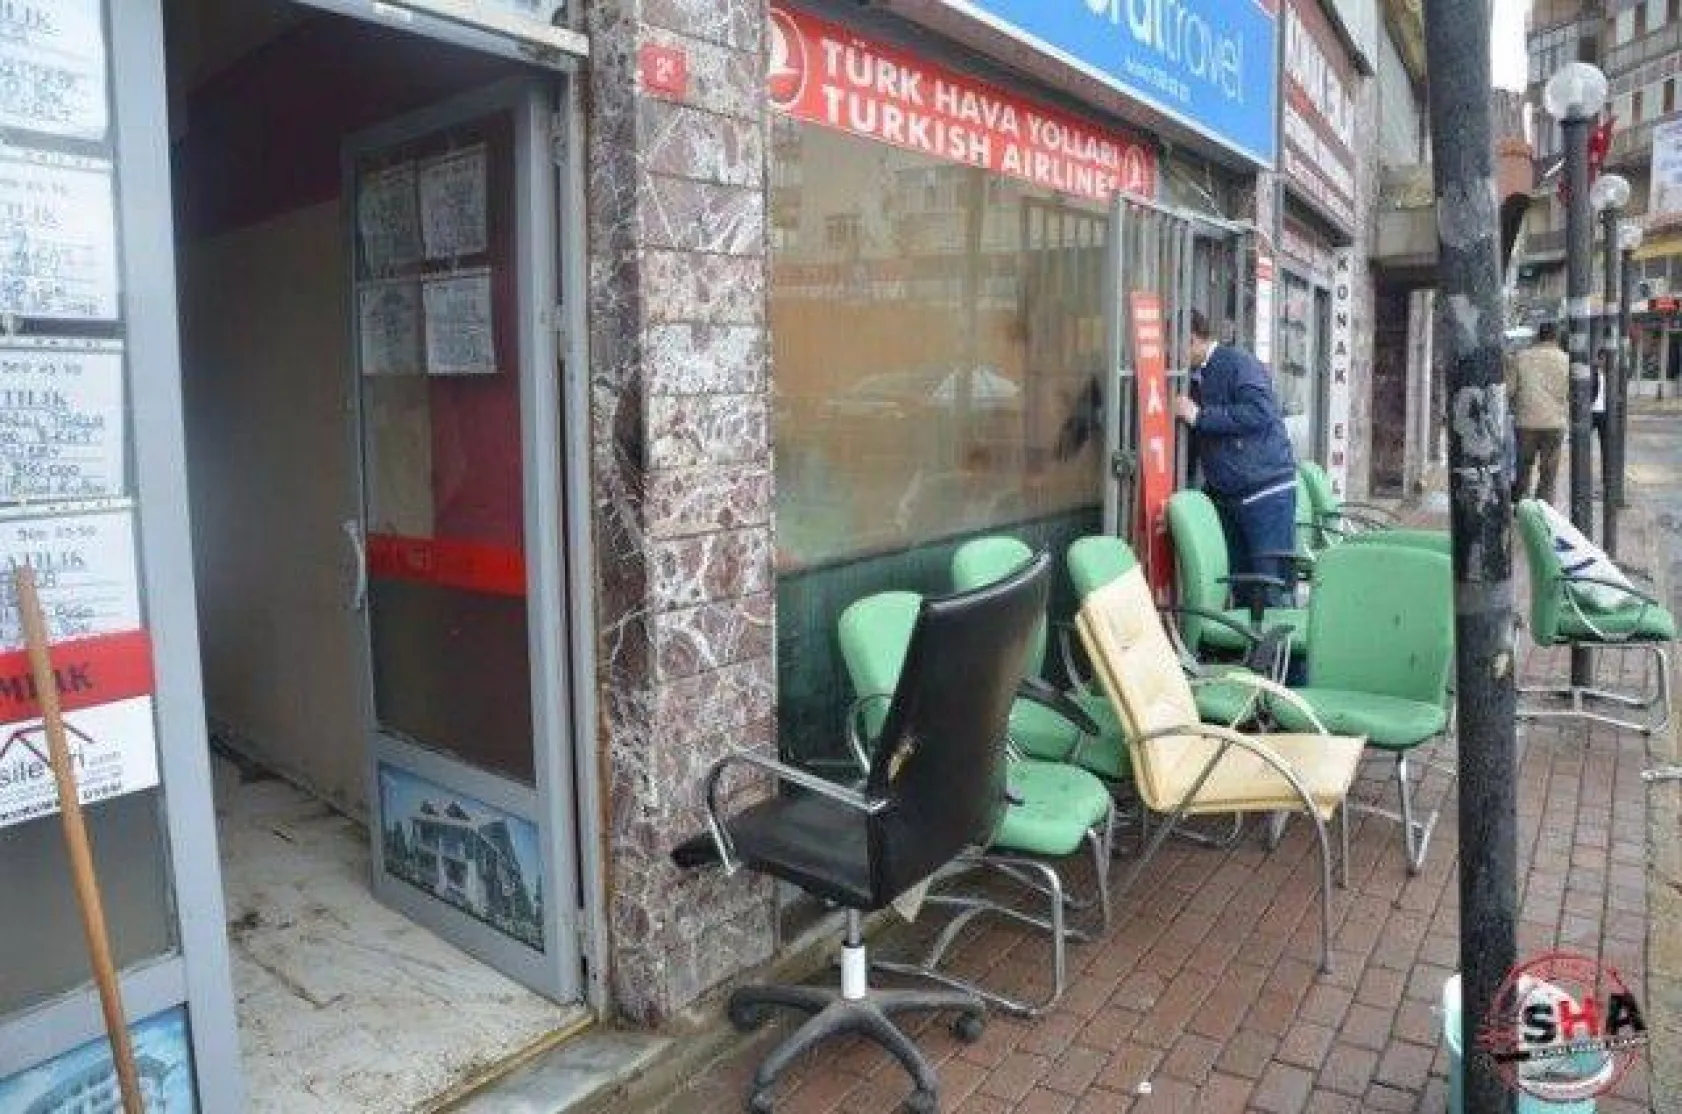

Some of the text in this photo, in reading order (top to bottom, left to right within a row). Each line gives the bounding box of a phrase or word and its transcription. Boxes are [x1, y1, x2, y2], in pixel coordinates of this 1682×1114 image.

[822, 38, 923, 106] TÜRK
[935, 82, 1019, 136] HAVA
[822, 85, 991, 166] TURKISH
[1334, 256, 1349, 385] KONAK
